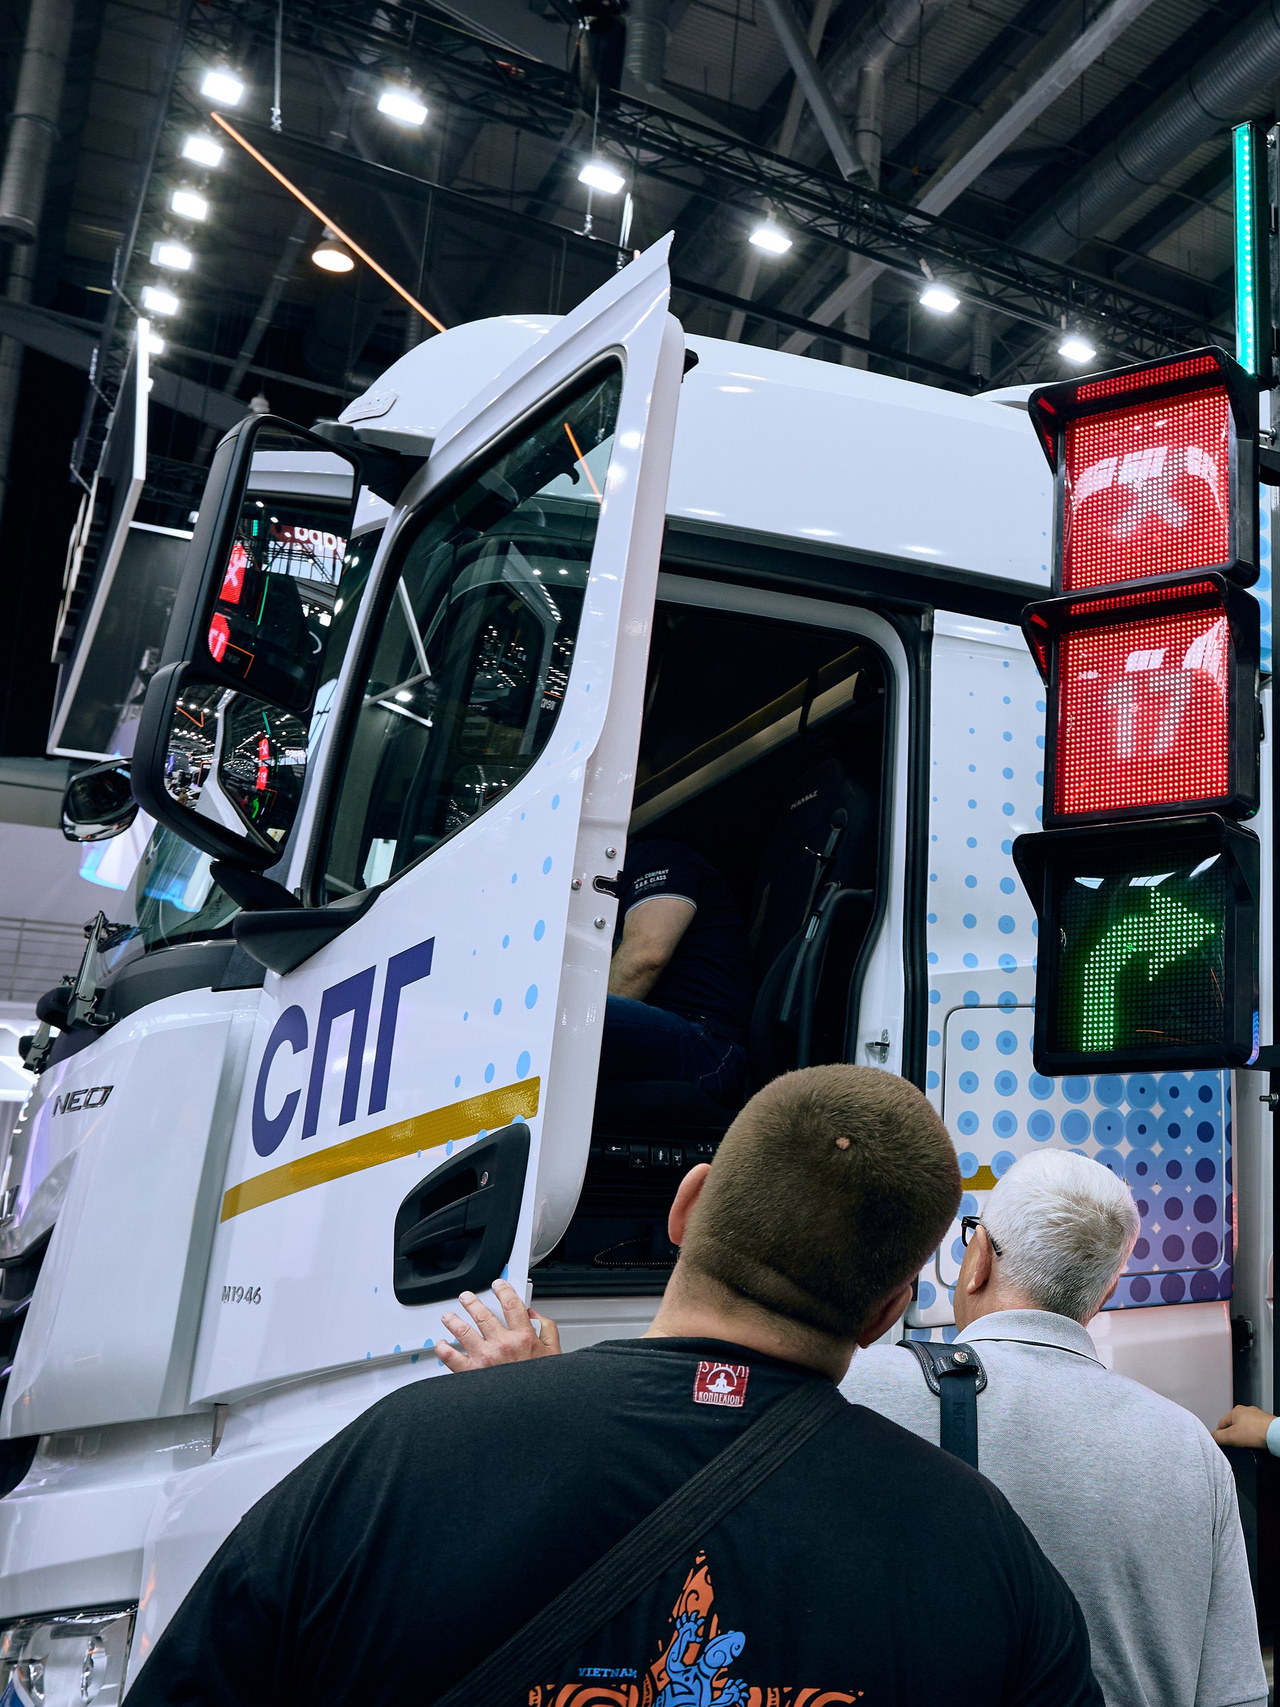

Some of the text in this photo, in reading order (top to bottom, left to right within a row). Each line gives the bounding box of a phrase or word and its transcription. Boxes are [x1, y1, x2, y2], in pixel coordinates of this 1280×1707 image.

[1103, 671, 1191, 759] 17
[251, 936, 436, 1157] СПГ
[52, 1085, 114, 1117] NEO
[221, 1285, 262, 1305] M1946
[578, 1667, 638, 1679] VIETNAM
